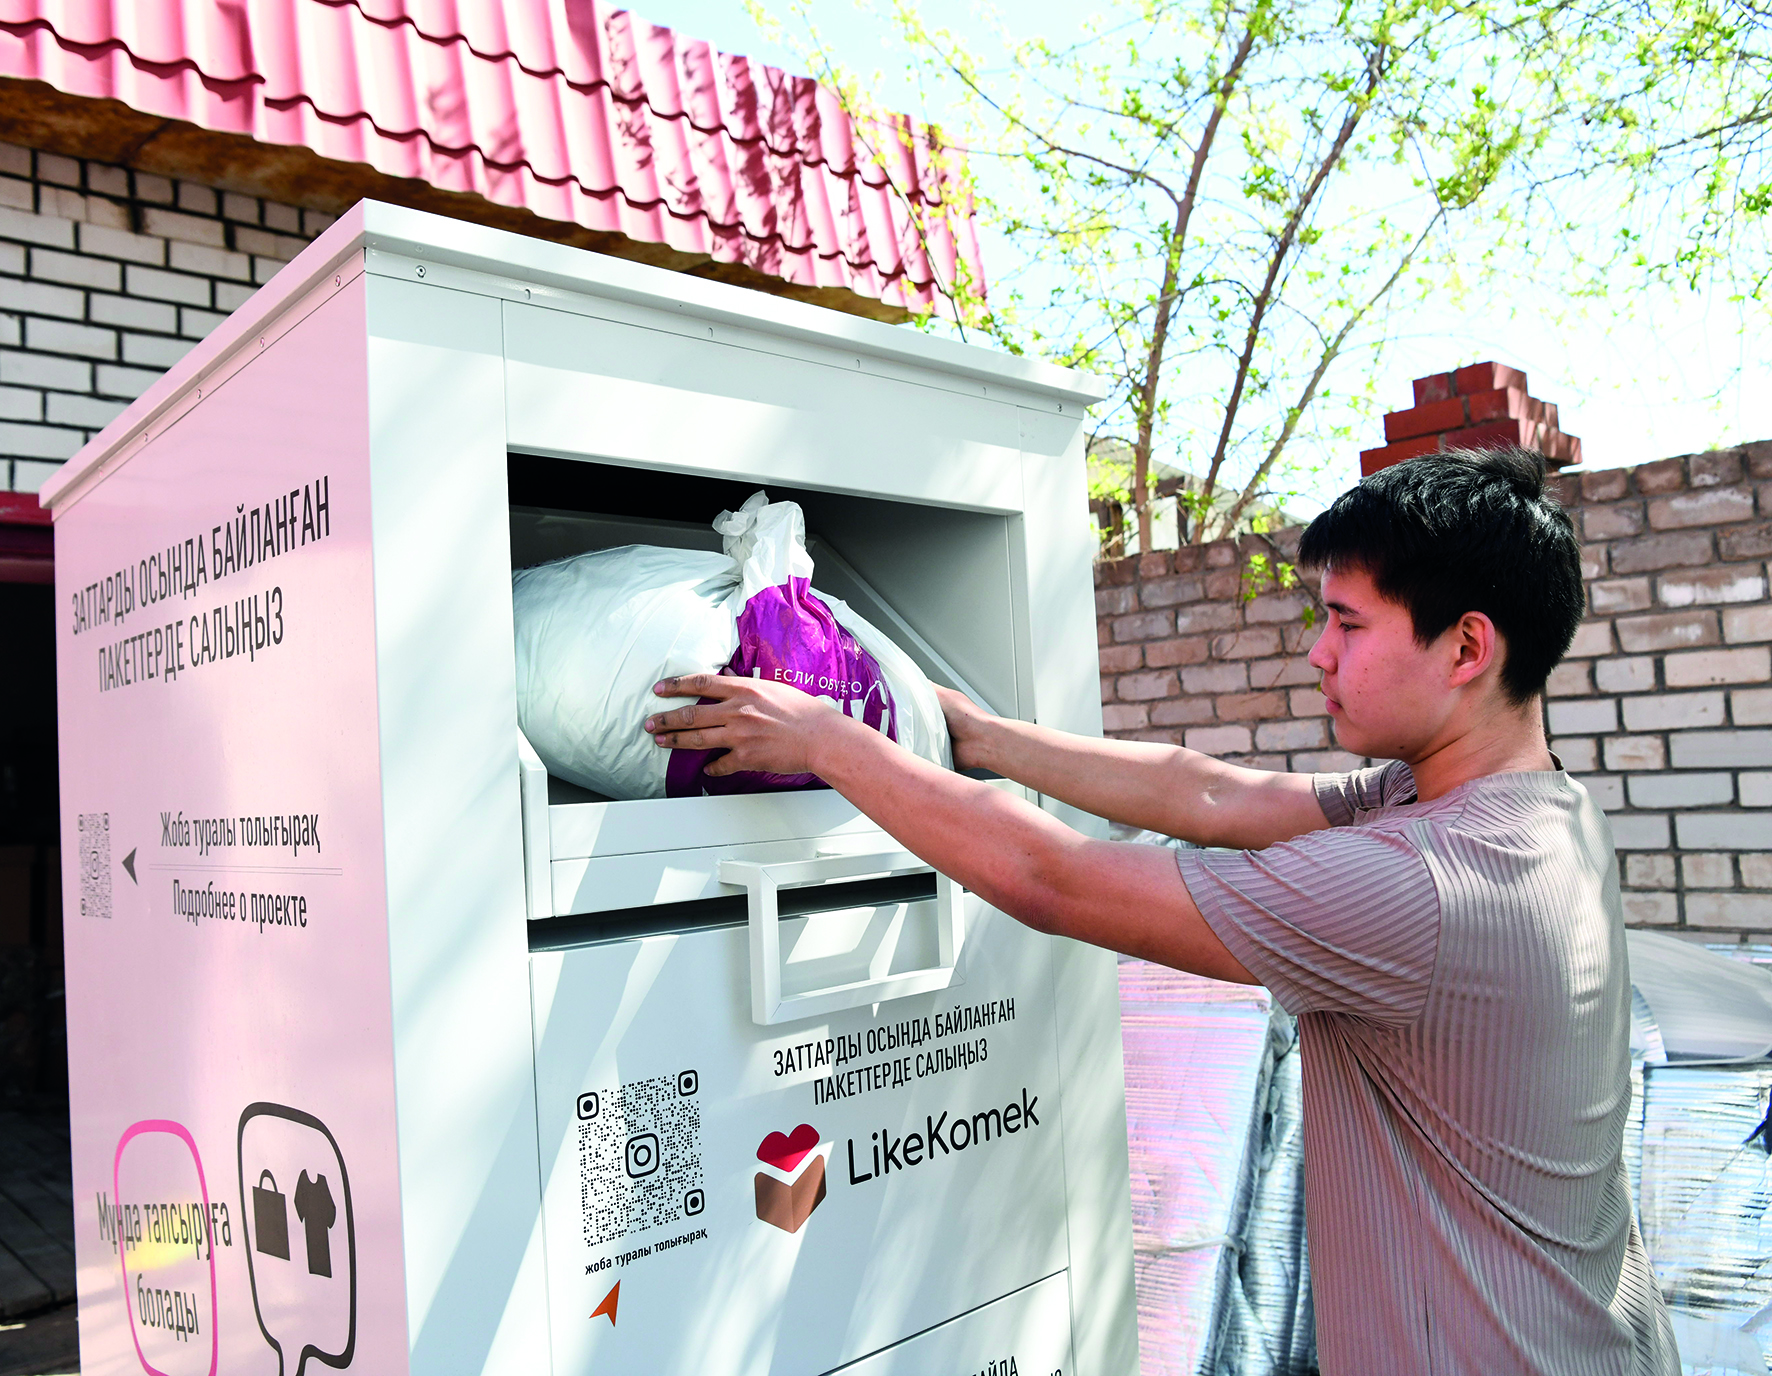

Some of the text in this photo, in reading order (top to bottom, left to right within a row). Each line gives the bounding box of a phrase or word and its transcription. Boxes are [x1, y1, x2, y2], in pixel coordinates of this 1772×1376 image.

[72, 475, 330, 635] ЗАТТАРДЫ ОСЫНДА БАЙЛАНҒАН
[98, 586, 283, 692] ПАКЕТТЕРДЕ САЛЫҢЫЗ
[774, 668, 815, 686] ЕСЛИ
[160, 811, 321, 857] Жоба туралы толығырақ
[173, 879, 308, 933] Подробнее о проекте
[773, 997, 1016, 1077] ЗАТТАРДЫ ОСЫНДА БАЙЛАНҒАН
[813, 1038, 988, 1106] ПАКЕТТЕРДЕ САЛЫҢЫЗ
[847, 1087, 1040, 1186] LikeKomek
[96, 1191, 233, 1261] Мұнда тапсыруға
[585, 1228, 708, 1276] жоба туралы толығырақ
[137, 1273, 199, 1343] болады
